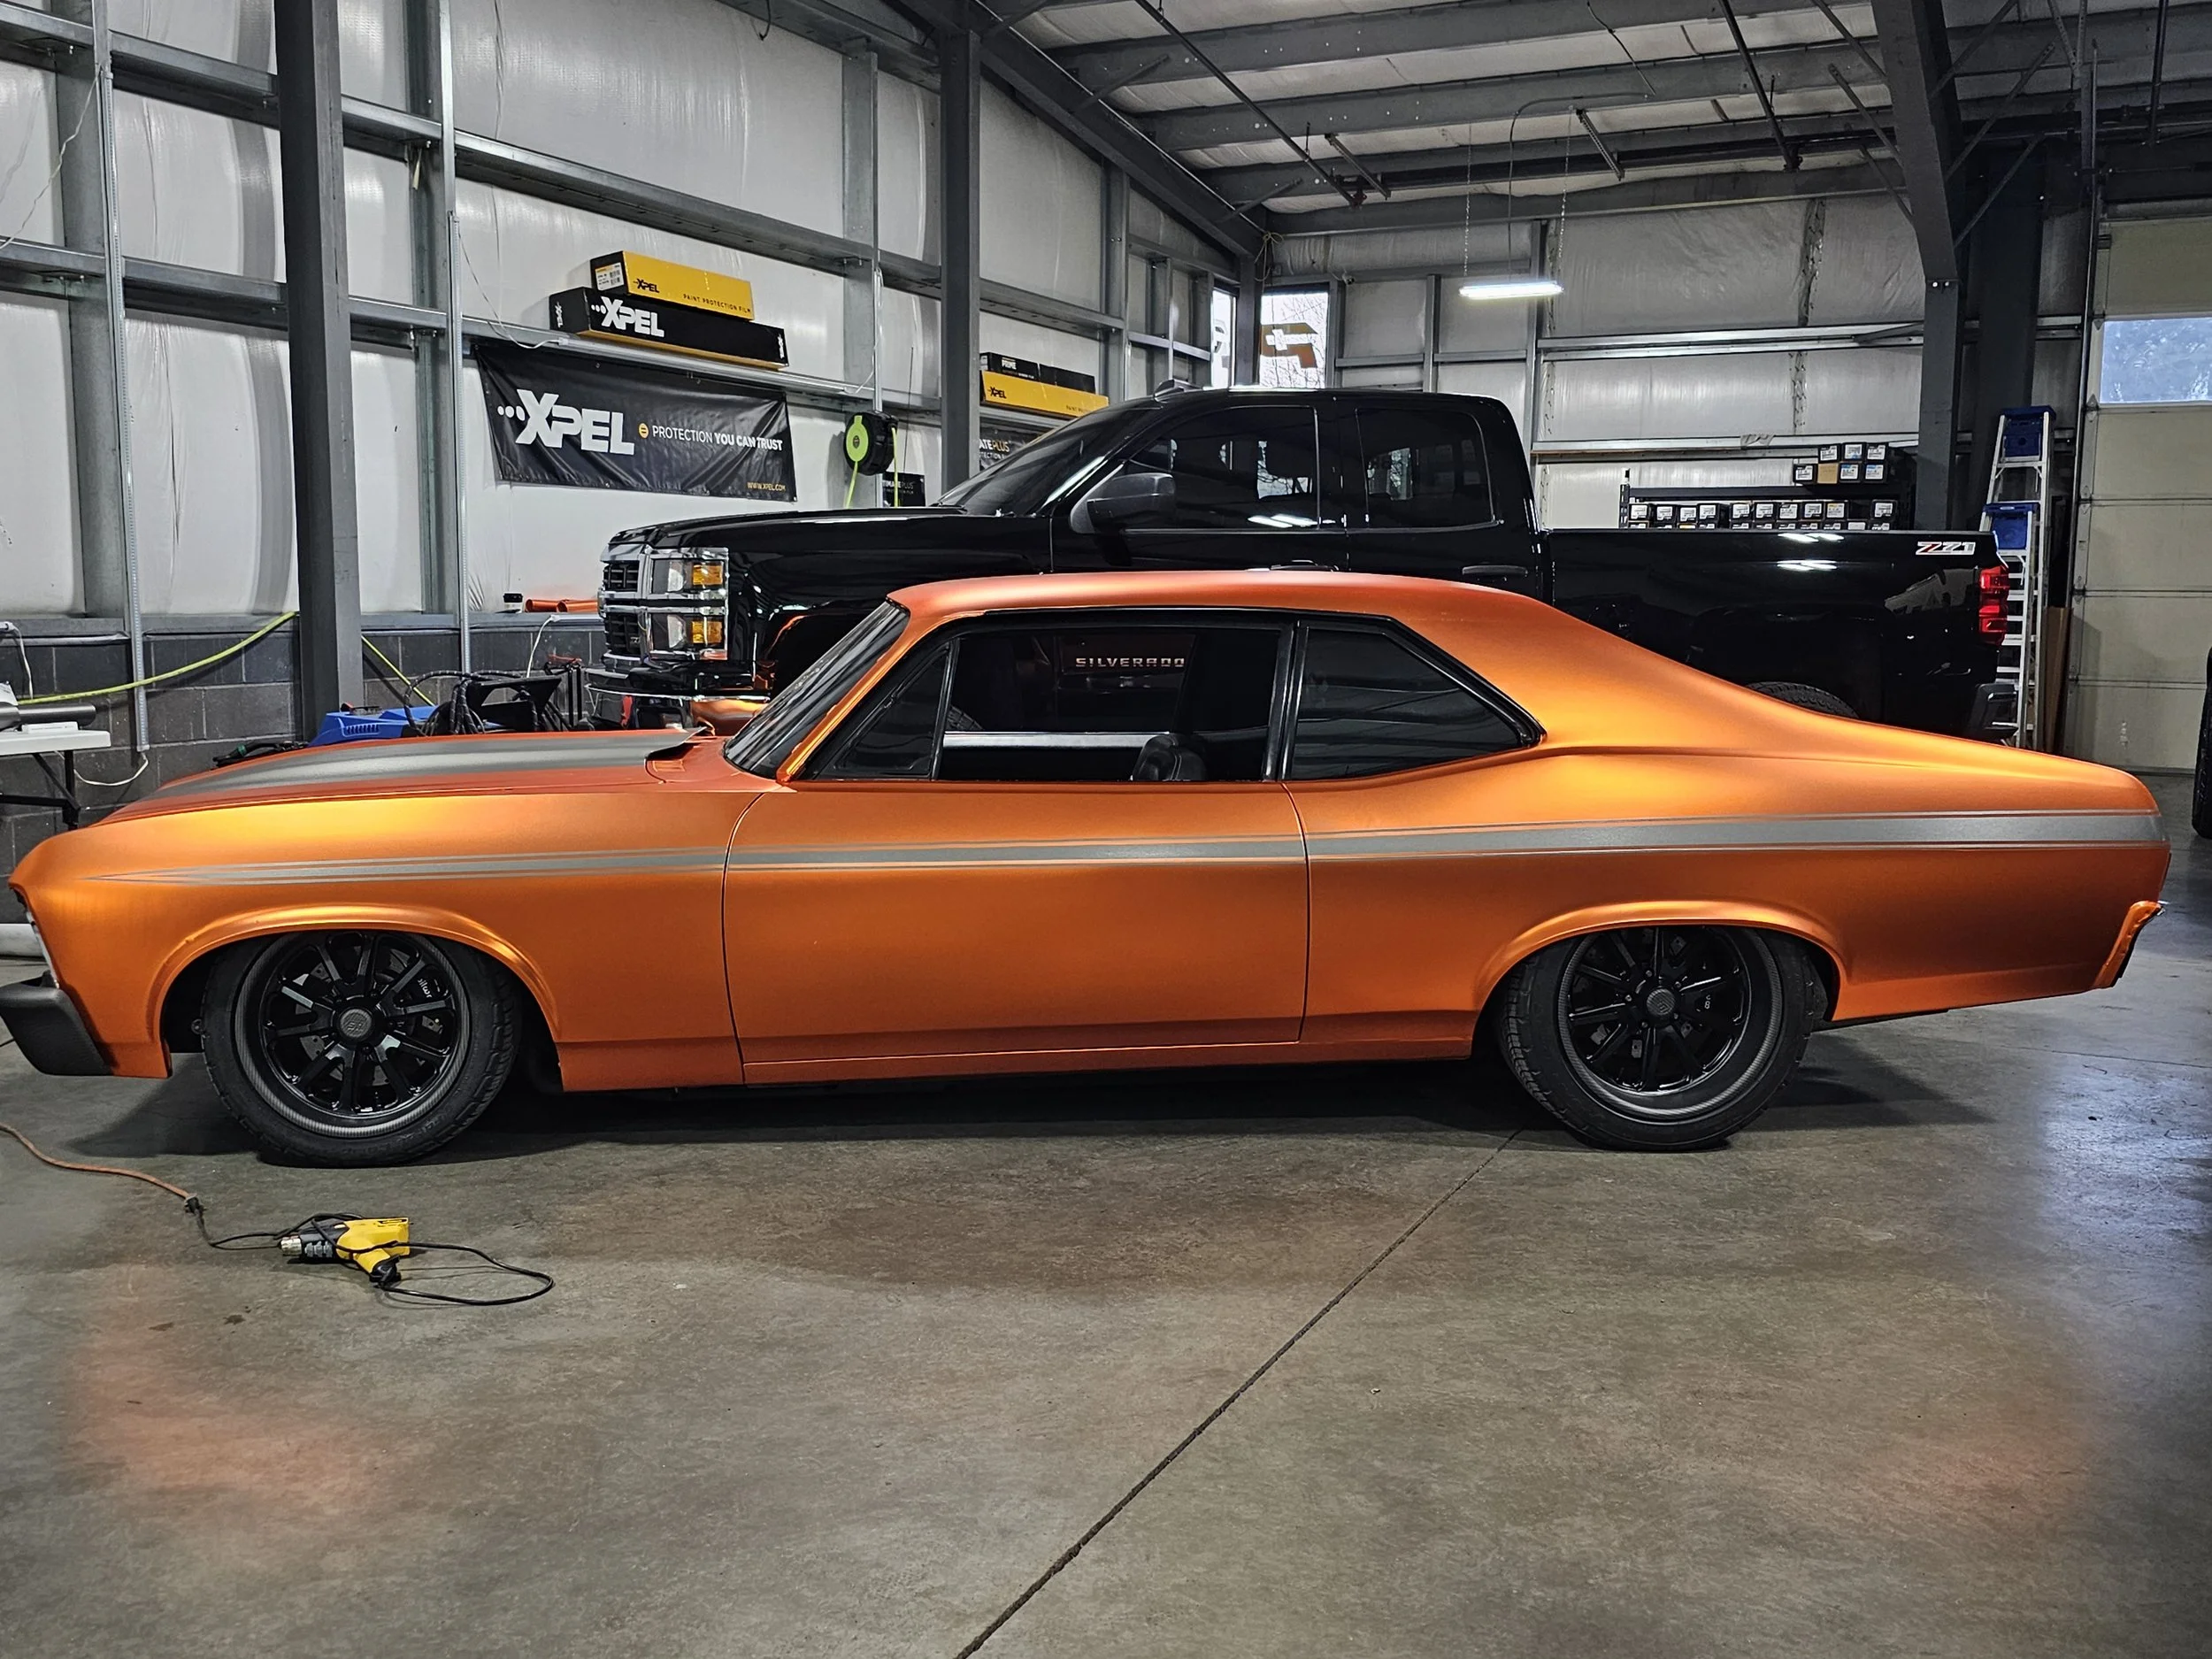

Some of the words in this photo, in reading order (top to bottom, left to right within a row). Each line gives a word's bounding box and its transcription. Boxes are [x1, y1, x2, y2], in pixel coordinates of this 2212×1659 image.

[635, 278, 660, 294] XPEL
[683, 293, 701, 303] PAINT
[703, 297, 738, 311] PROTECTION
[601, 296, 664, 338] XPEL
[989, 386, 1007, 399] XPEL
[515, 388, 635, 456] XPEL
[652, 425, 713, 443] PROTECTION
[714, 432, 735, 446] YOU
[736, 436, 757, 448] CAN
[757, 437, 783, 451] TRUST
[1916, 541, 1976, 556] Z71
[1075, 657, 1186, 667] SILVERADO
